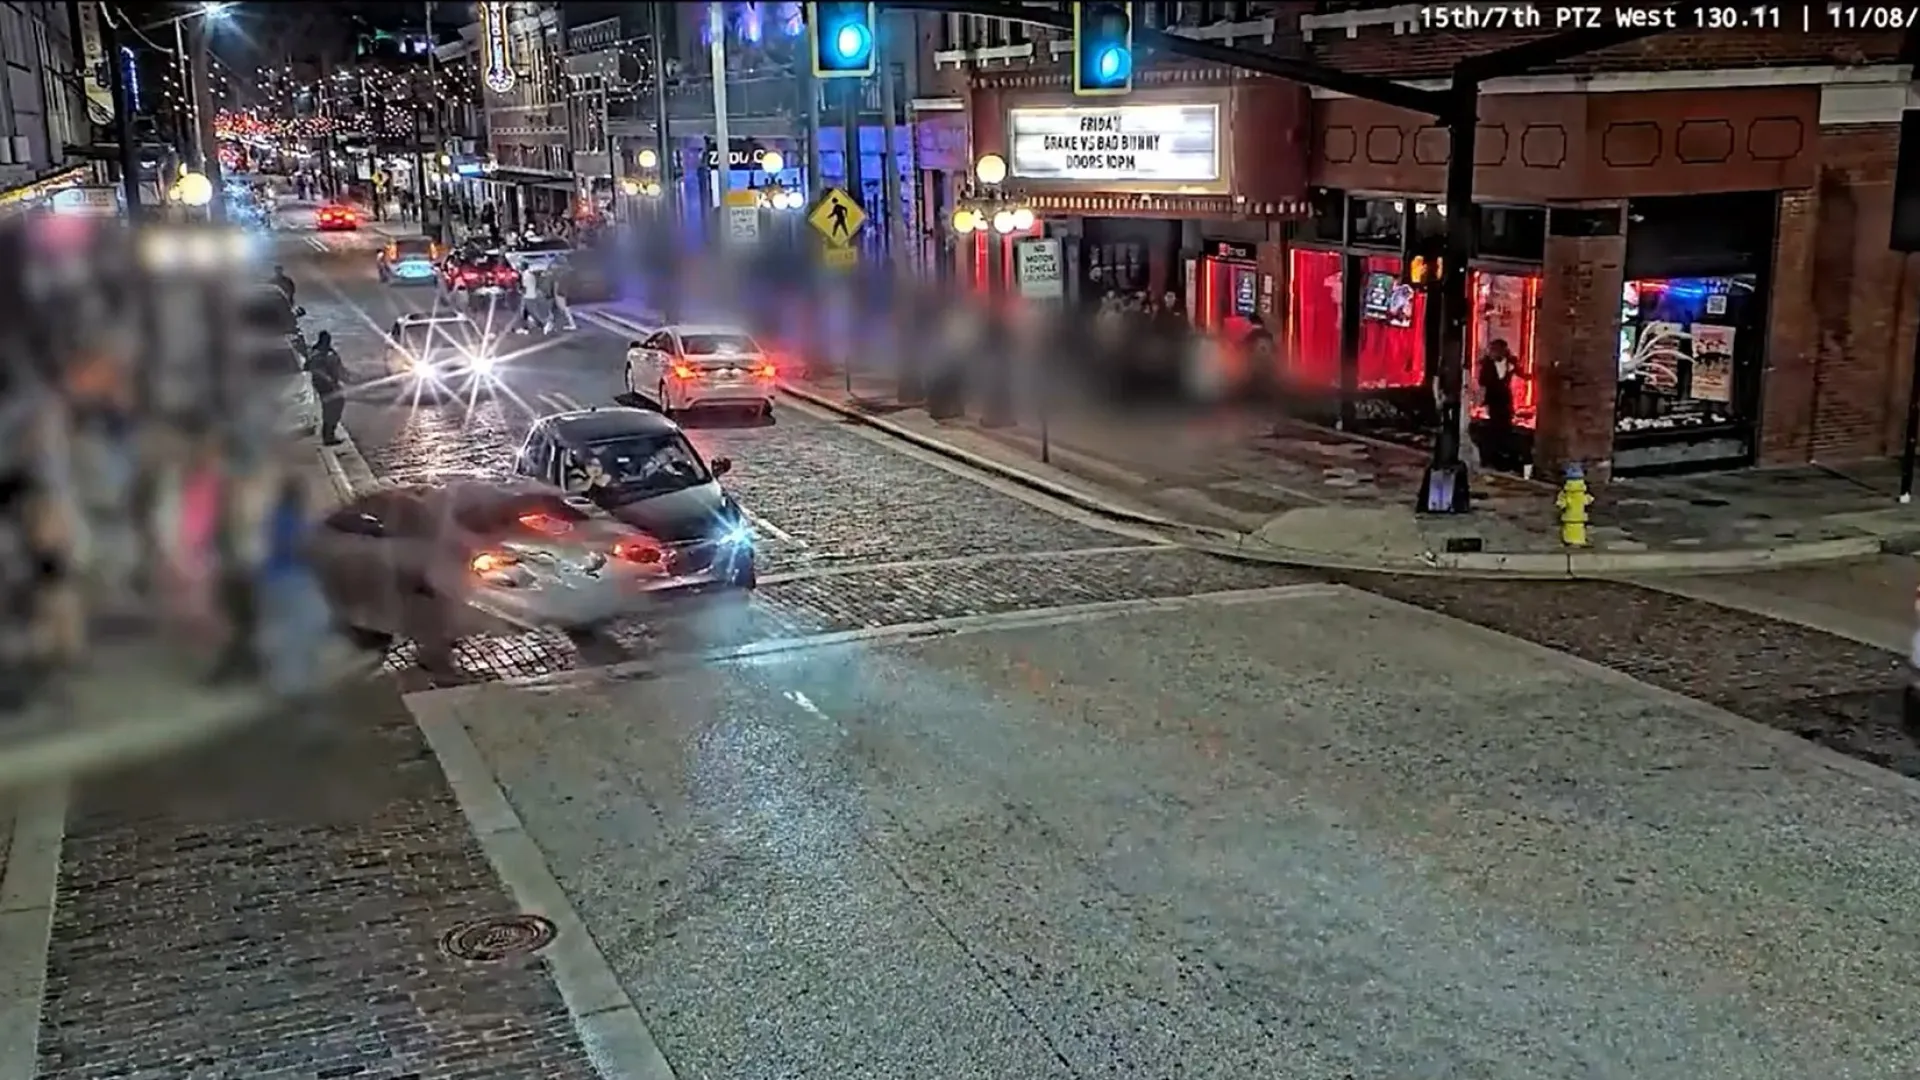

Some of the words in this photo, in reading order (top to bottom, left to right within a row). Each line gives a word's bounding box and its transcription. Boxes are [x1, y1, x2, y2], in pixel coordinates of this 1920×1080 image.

[1080, 116, 1122, 132] FRIDAY
[1044, 136, 1078, 151] DRAKE
[1080, 136, 1095, 151] VS
[1097, 136, 1119, 150] BAD
[1122, 135, 1160, 150] BUNNY
[1066, 155, 1103, 169] DOORS
[1107, 155, 1136, 169] 10PM
[733, 225, 756, 238] 25
[1034, 244, 1046, 253] NO
[1026, 254, 1054, 263] MOTOR
[1025, 263, 1056, 273] VEHICLE
